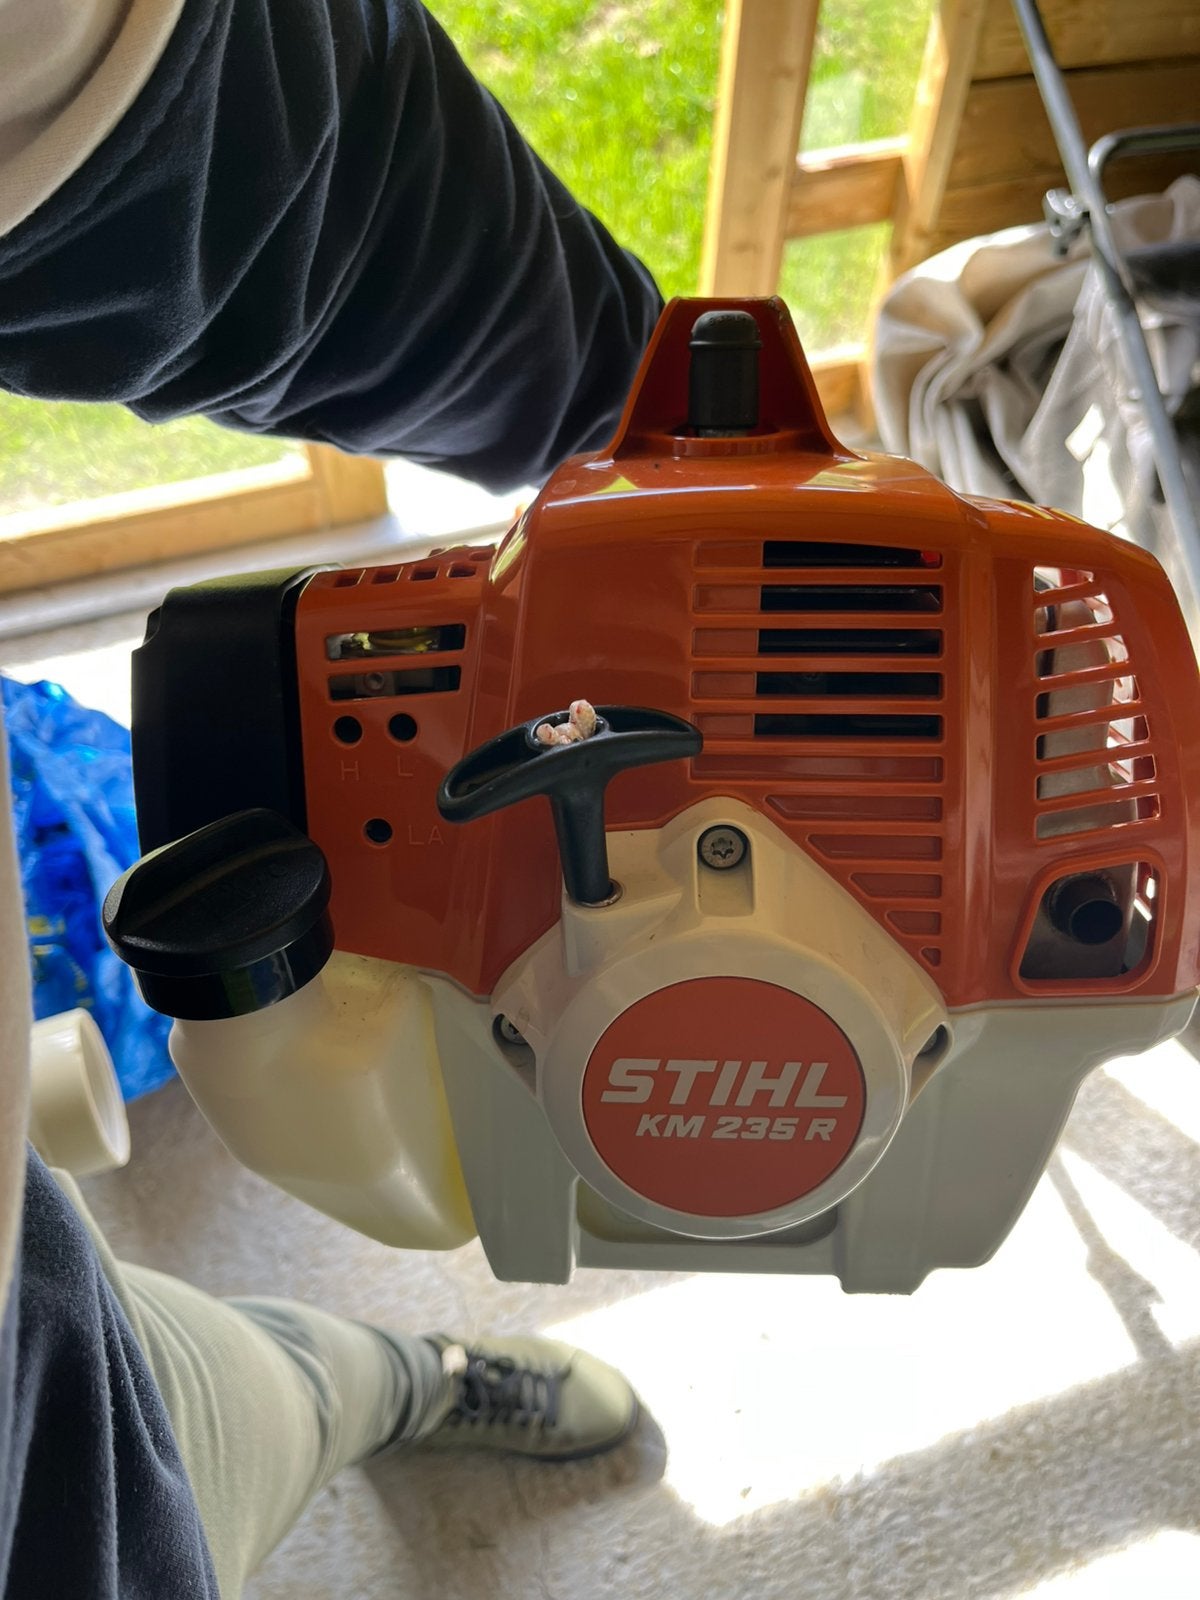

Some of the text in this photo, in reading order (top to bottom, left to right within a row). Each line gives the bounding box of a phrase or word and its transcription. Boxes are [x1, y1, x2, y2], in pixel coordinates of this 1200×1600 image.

[340, 759, 360, 781] H
[396, 754, 414, 777] L
[408, 824, 444, 845] LA
[600, 1057, 848, 1108] STIHL
[635, 1113, 838, 1141] KM 235 R
